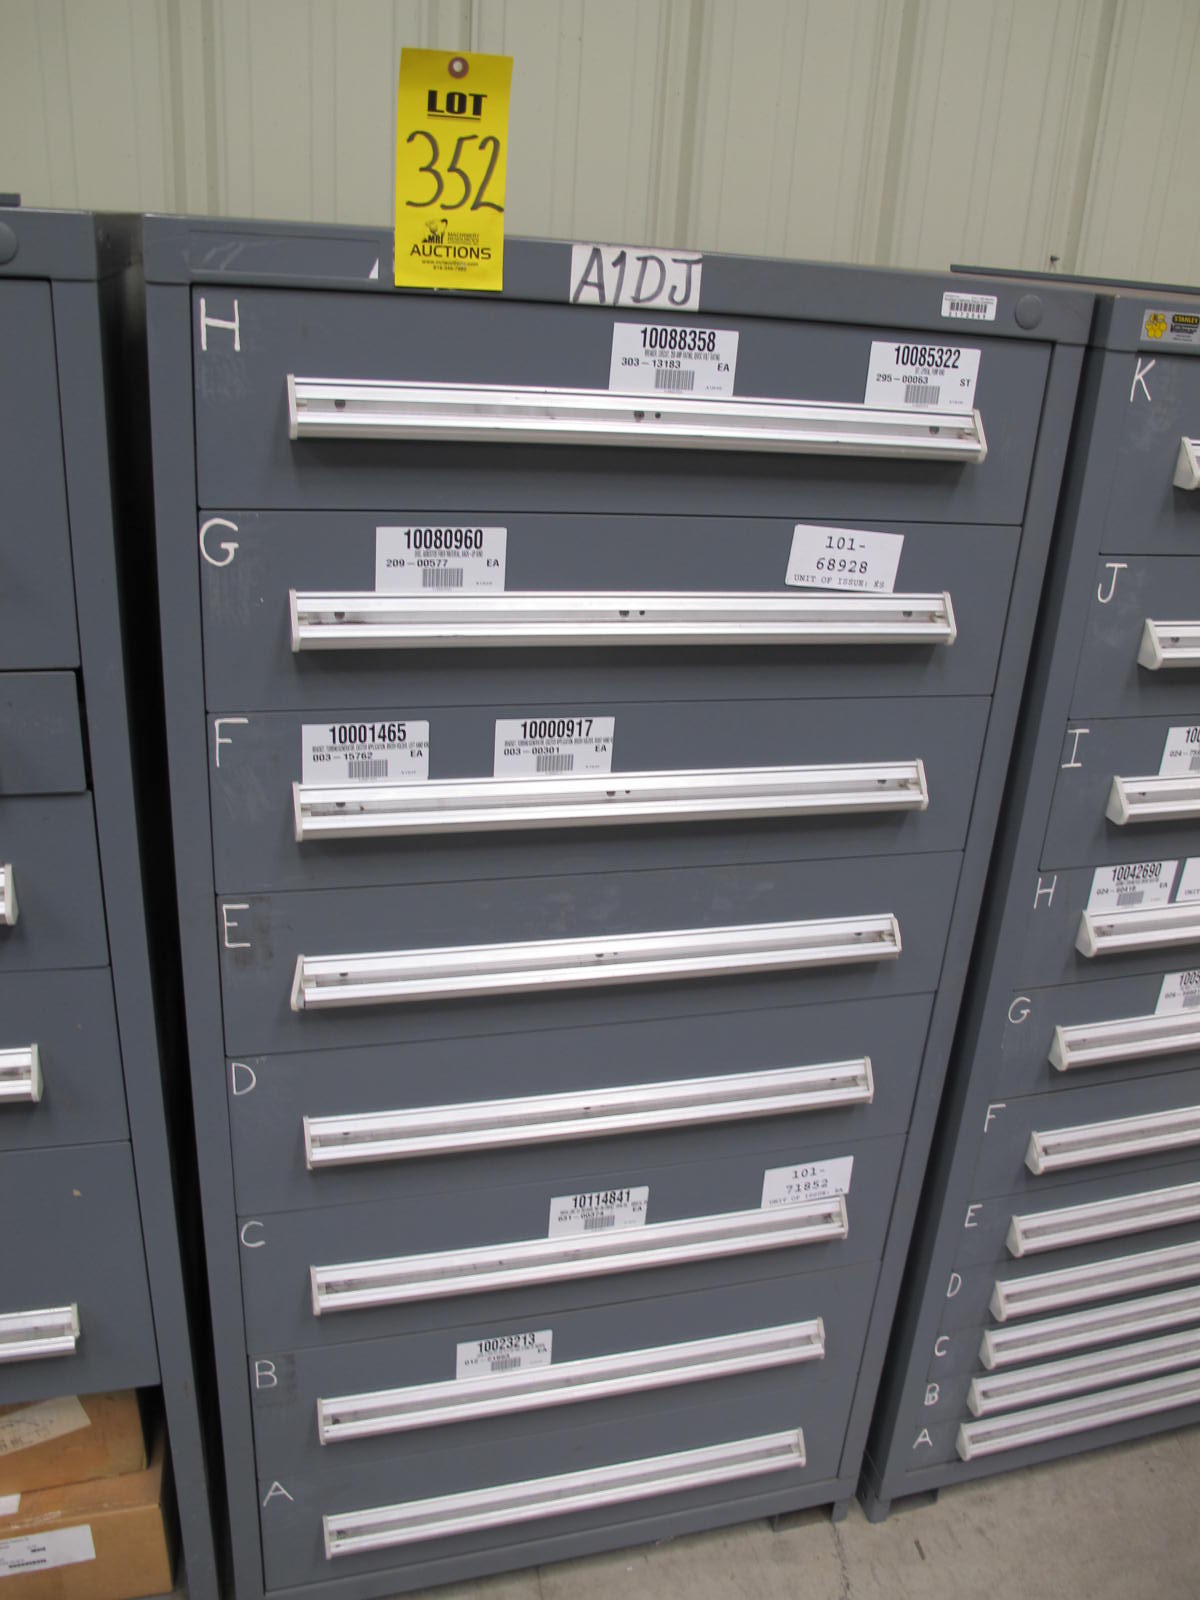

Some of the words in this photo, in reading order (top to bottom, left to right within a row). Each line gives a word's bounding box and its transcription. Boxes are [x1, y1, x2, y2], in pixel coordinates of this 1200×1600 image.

[427, 89, 488, 117] LOT
[405, 130, 504, 214] 352
[410, 244, 492, 261] AUCTIONS
[572, 247, 703, 308] A1DJ
[200, 297, 241, 352] H
[640, 327, 717, 352] 10088358
[716, 362, 730, 372] EA
[894, 345, 962, 370] 10085322
[959, 378, 971, 388] ST
[1130, 357, 1156, 402] K
[199, 517, 240, 566] G
[403, 528, 484, 550] 10080960
[825, 535, 867, 551] 101-
[486, 558, 500, 568] EA
[816, 557, 868, 575] 68928
[793, 573, 816, 584] UNIT
[820, 576, 833, 585] OF
[1097, 563, 1128, 603] J
[328, 723, 407, 745] 10001465
[520, 719, 594, 739] 10000917
[213, 717, 249, 768] F
[409, 749, 423, 759] EA
[1061, 728, 1090, 768] I
[1112, 862, 1163, 882] 10042690
[1033, 875, 1058, 909] H
[222, 903, 251, 948] E
[1008, 996, 1031, 1024] G
[231, 1062, 257, 1096] D
[983, 1103, 1006, 1133] F
[572, 1189, 631, 1209] 10114841
[964, 1204, 983, 1228] E
[240, 1219, 266, 1249] C
[946, 1273, 962, 1298] D
[478, 1332, 536, 1354] 10023213
[933, 1335, 950, 1357] C
[254, 1360, 278, 1390] B
[923, 1382, 941, 1406] B
[912, 1427, 934, 1449] A
[262, 1480, 295, 1508] A
